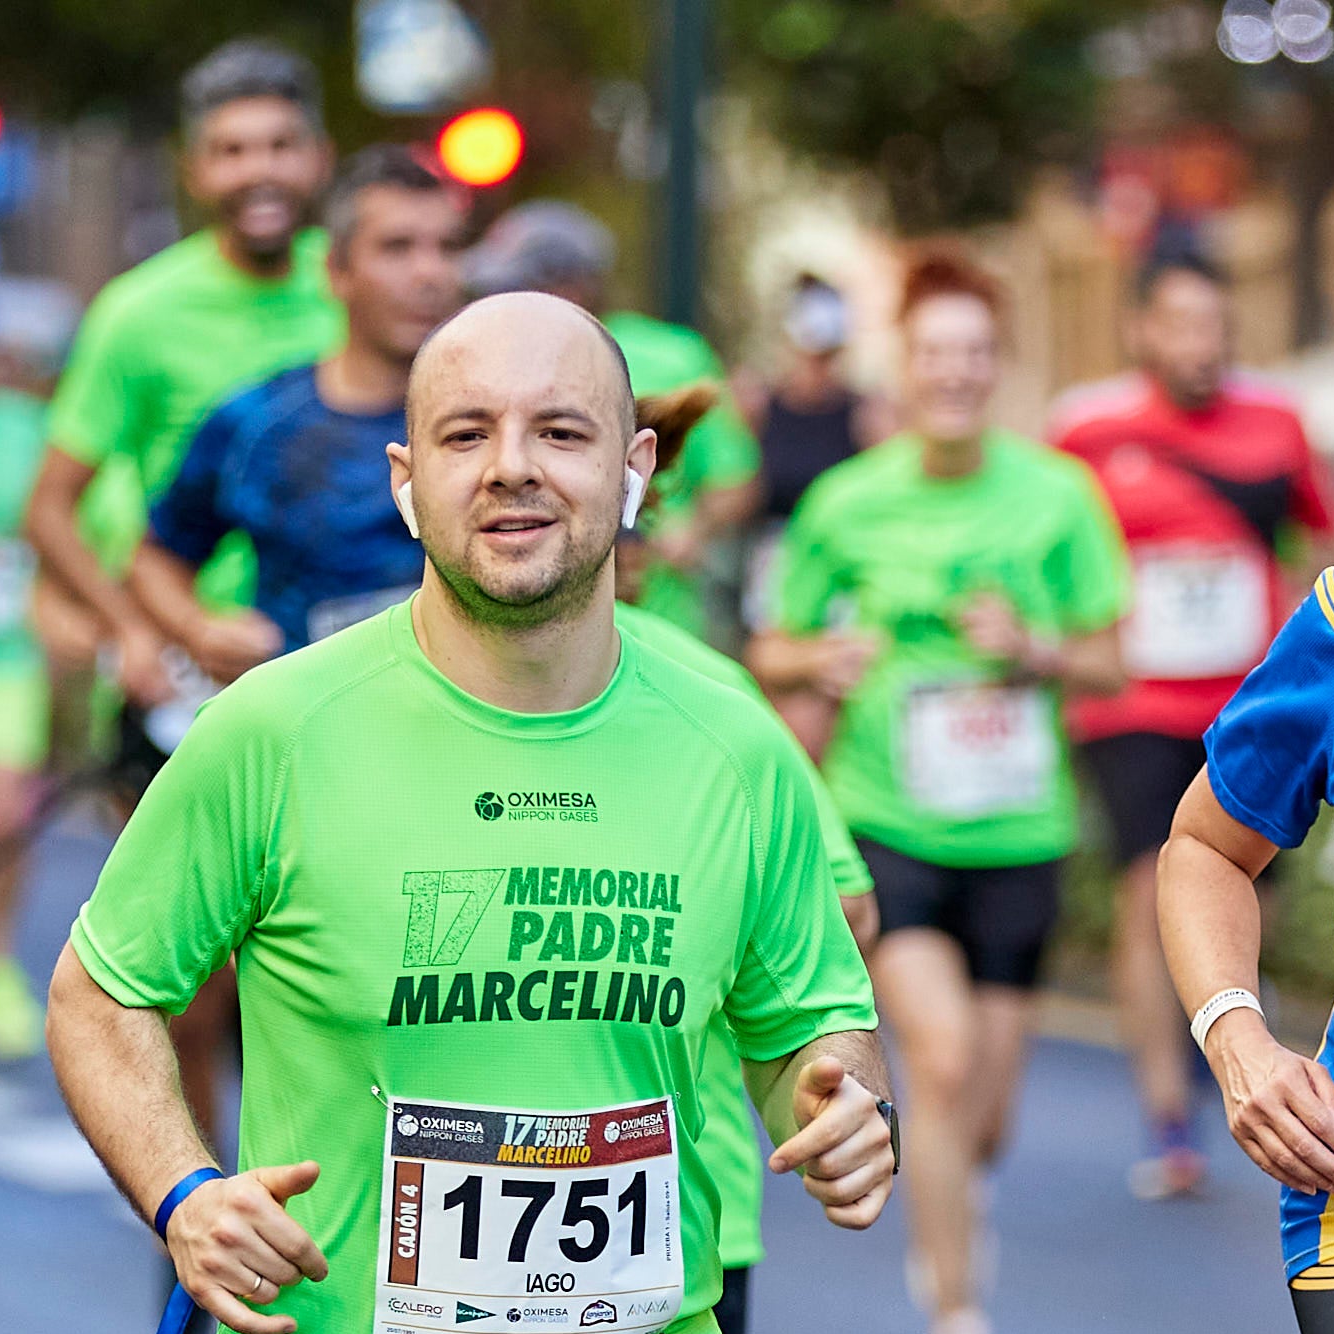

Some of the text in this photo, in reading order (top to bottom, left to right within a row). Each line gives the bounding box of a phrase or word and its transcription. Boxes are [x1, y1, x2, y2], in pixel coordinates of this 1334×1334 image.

[508, 791, 597, 809] OXIMESA
[508, 811, 599, 823] NIPPON GASES
[504, 867, 683, 914] MEMORIAL
[402, 869, 507, 968] 17
[507, 911, 675, 967] PADRE
[386, 970, 686, 1027] MARCELINO
[420, 1116, 485, 1135] OXIMESA
[504, 1115, 536, 1146] 17
[535, 1116, 591, 1130] MEMORIAL
[620, 1113, 663, 1131] OXIMESA
[419, 1130, 484, 1144] NIPPON GASES
[535, 1129, 587, 1147] PADRE
[641, 1126, 665, 1139] GASES
[496, 1144, 592, 1164] MARCELINO
[395, 1184, 418, 1259] CAJÓN 4
[443, 1170, 647, 1263] 1751
[526, 1273, 576, 1293] IAGO
[392, 1300, 443, 1315] CALERO
[523, 1308, 568, 1316] OXIMESA
[627, 1300, 670, 1317] ANAYA
